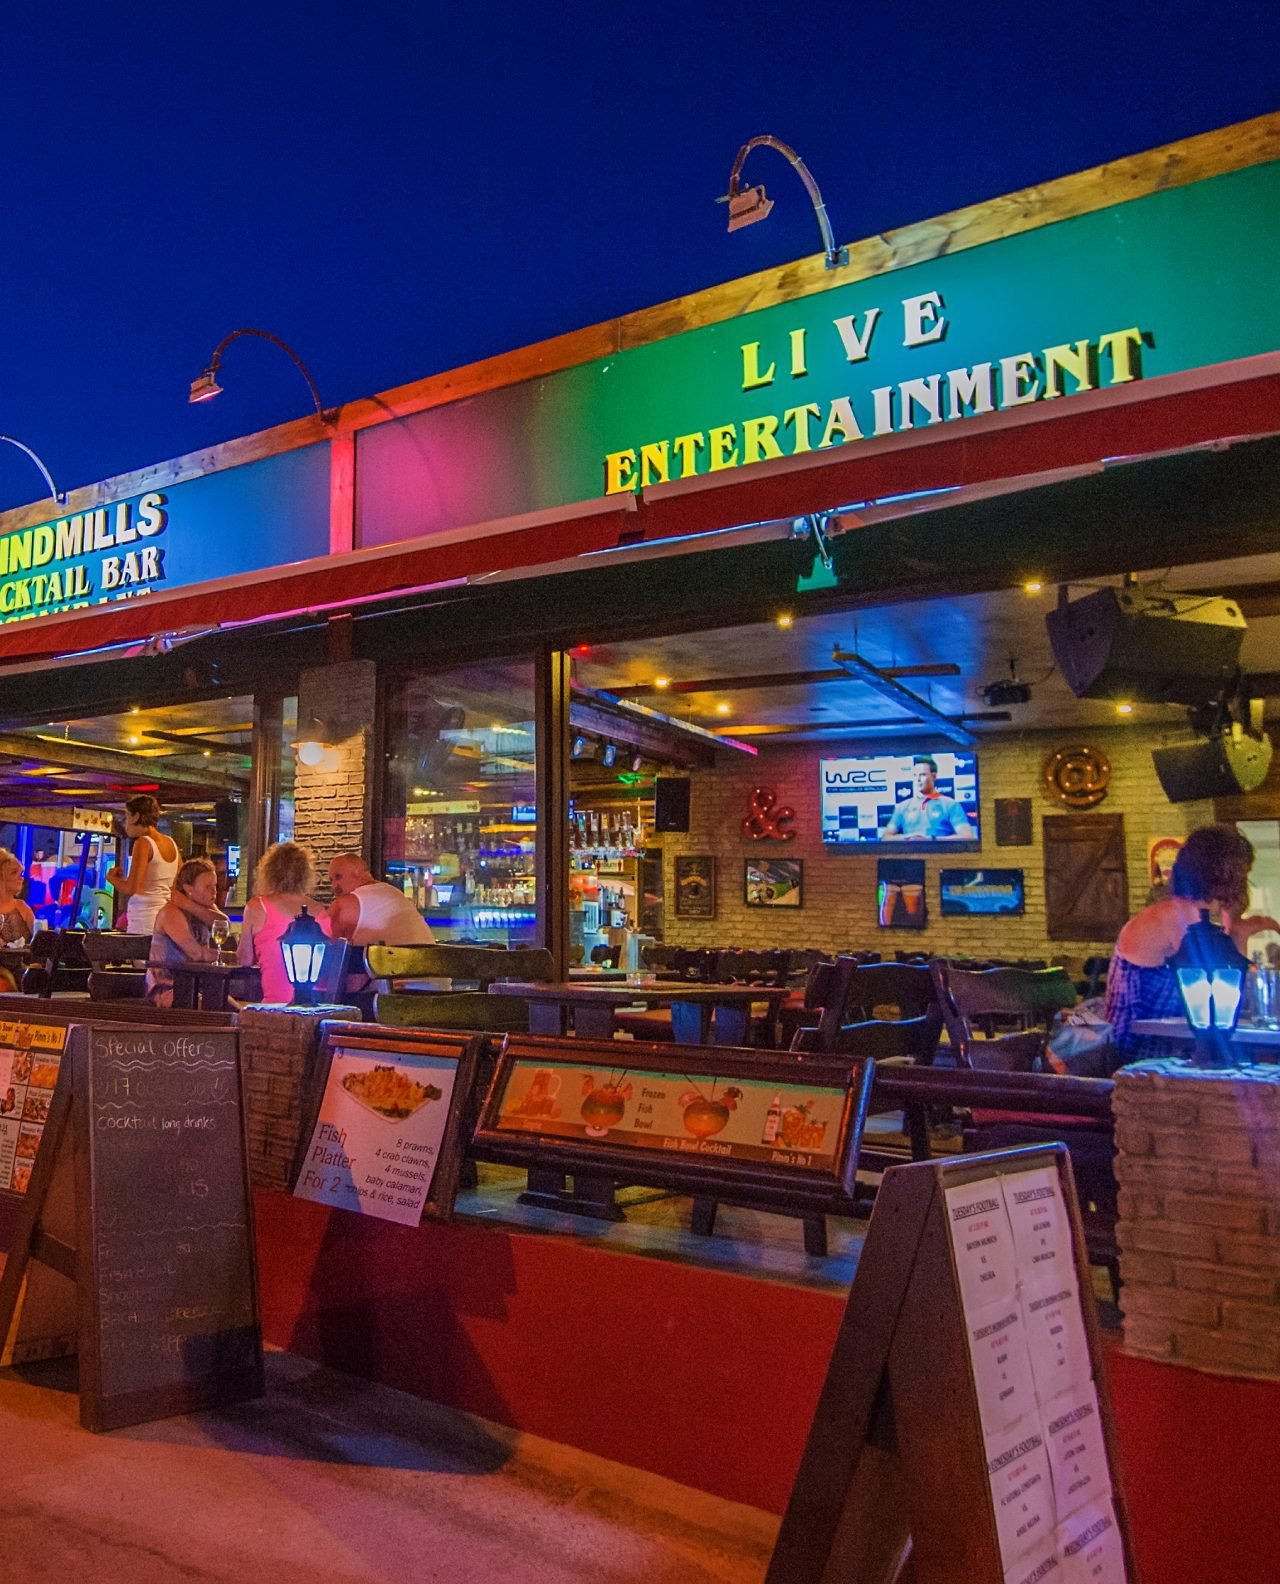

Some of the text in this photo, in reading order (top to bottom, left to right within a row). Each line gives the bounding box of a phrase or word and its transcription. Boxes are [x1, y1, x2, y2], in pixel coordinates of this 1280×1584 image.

[740, 290, 946, 390] LIVE
[605, 326, 1144, 496] ENTERTAINMENT
[100, 546, 162, 589] BAR
[825, 769, 887, 784] WRC
[641, 1087, 667, 1100] Frozen
[637, 1103, 653, 1115] Fish
[633, 1118, 654, 1130] Bowl
[318, 1124, 348, 1149] Fish
[310, 1145, 357, 1171] Platter
[375, 1148, 382, 1158] 4
[381, 1150, 401, 1163] crab
[384, 1163, 391, 1174] 4
[302, 1169, 342, 1194] For 2
[365, 1174, 386, 1189] baby
